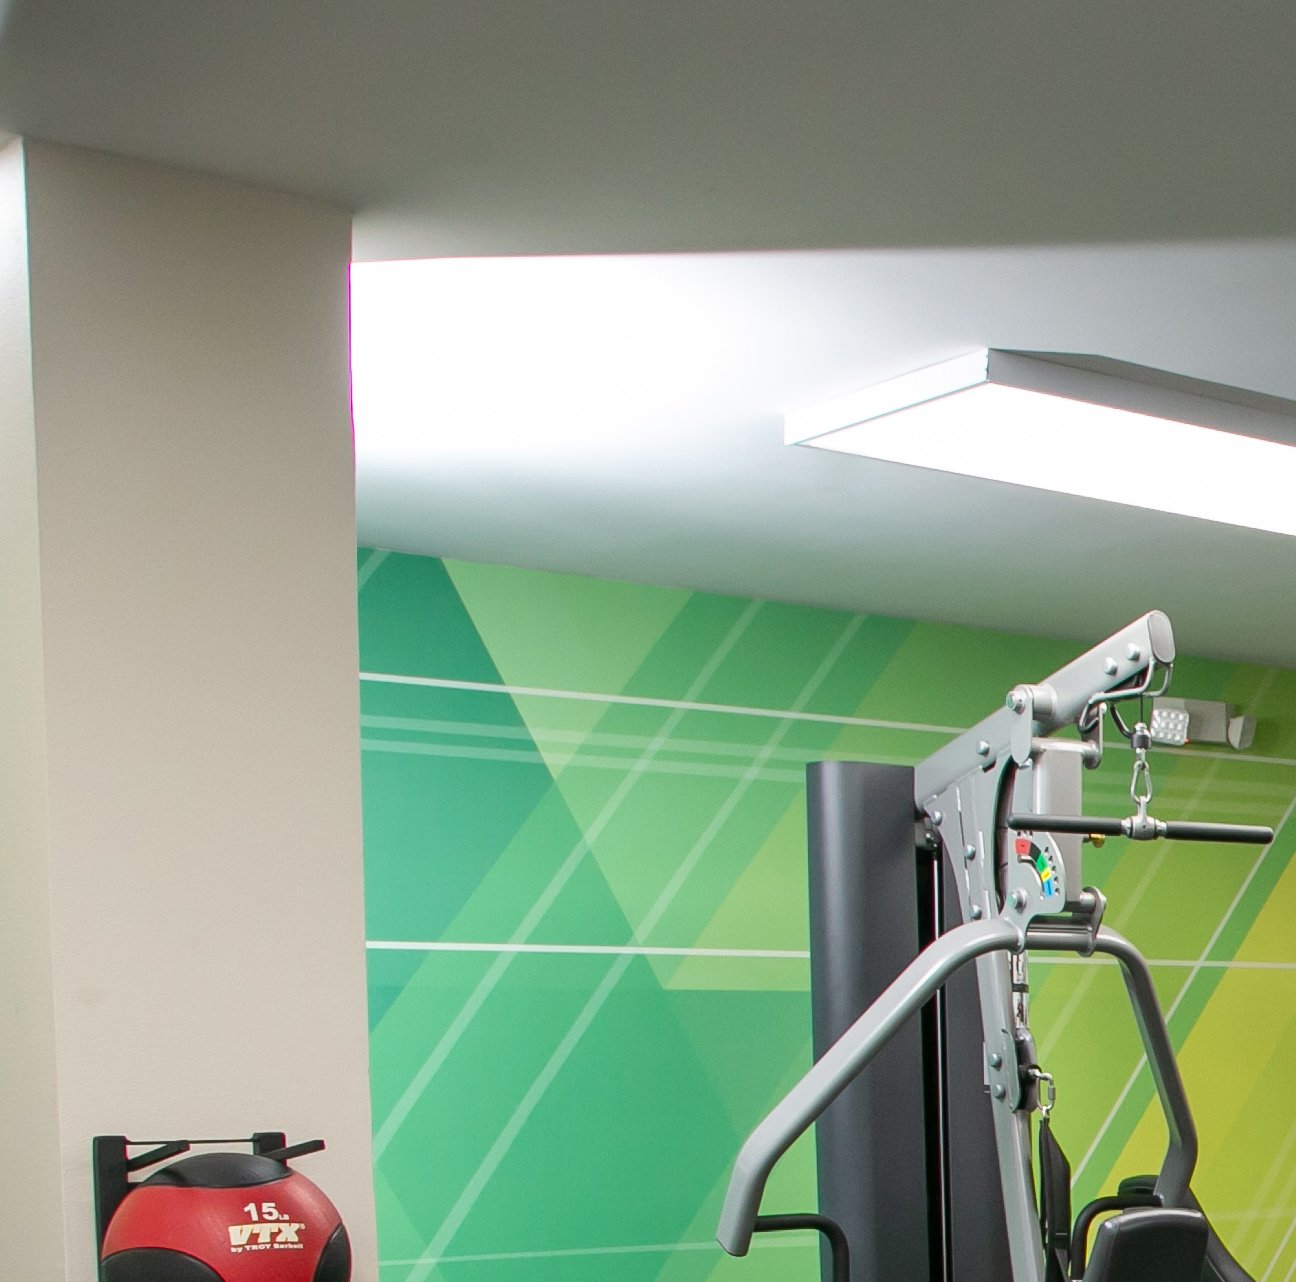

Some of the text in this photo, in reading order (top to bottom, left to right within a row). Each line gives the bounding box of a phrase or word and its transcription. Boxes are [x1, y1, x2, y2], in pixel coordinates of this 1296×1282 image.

[243, 1202, 279, 1222] 15
[228, 1222, 301, 1246] VTX
[273, 1242, 304, 1250] Barbell
